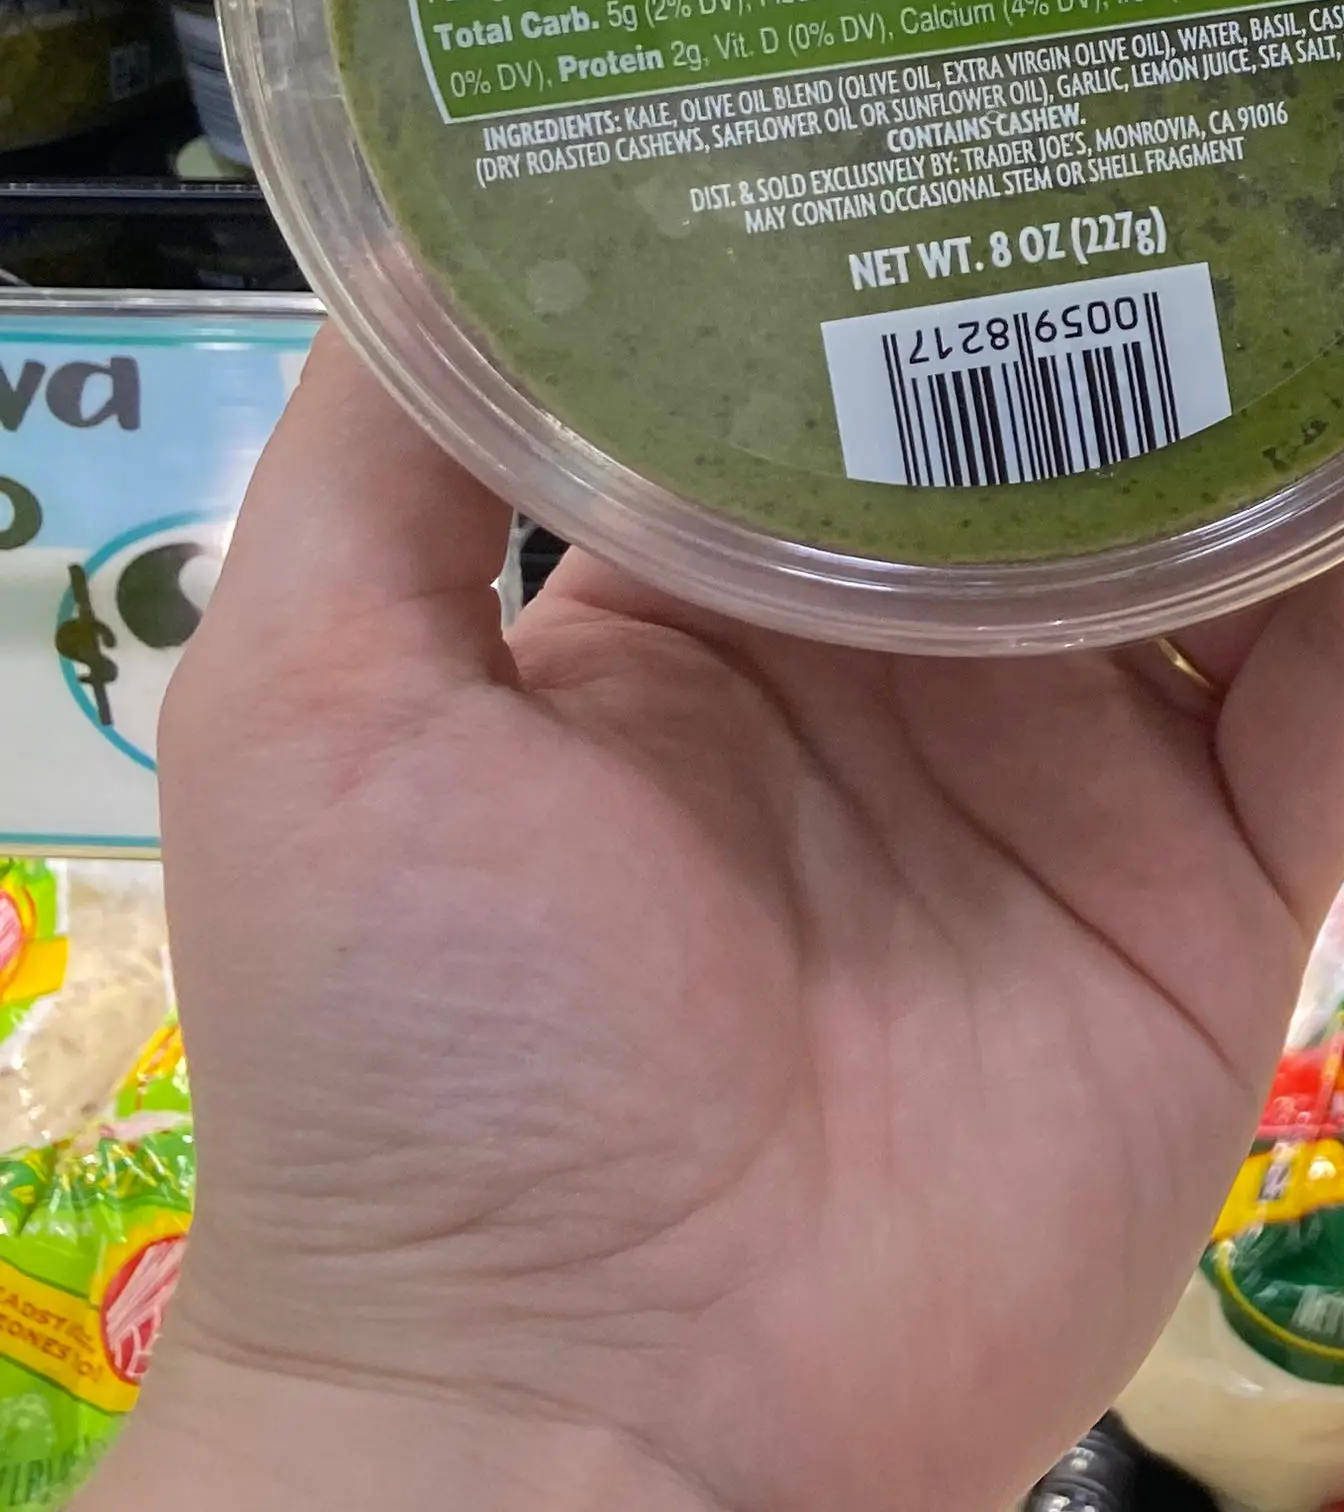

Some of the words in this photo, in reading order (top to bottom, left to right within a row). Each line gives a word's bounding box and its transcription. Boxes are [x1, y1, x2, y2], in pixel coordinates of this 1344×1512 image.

[483, 111, 622, 151] INGREDIENTS:
[625, 104, 677, 131] KALE,
[682, 94, 738, 122] OLIVE
[741, 90, 771, 115] OIL
[774, 81, 833, 112] BLEND
[839, 70, 899, 104] (OLIVE
[903, 64, 942, 92] OIL,
[943, 54, 1003, 85] EXTRA
[1006, 46, 1070, 77] VIRGIN
[1076, 38, 1128, 66] OLIVE
[1131, 30, 1176, 60] OIL),
[1178, 22, 1248, 52] WATER,
[1251, 13, 1305, 42] BASIL,
[887, 118, 990, 153] CONTAINS
[998, 103, 1086, 136] CASHEW.
[691, 186, 736, 213] DIST.
[740, 184, 754, 204] &
[757, 175, 806, 204] SOLD
[811, 159, 923, 196] EXCLUSIVELY
[930, 154, 961, 178] BY:
[965, 140, 1035, 173] TRADER
[1038, 134, 1091, 163] JOE'S,
[1096, 118, 1204, 153] MONROVIA,
[1209, 111, 1233, 134] CA
[1236, 103, 1289, 131] 91016
[848, 247, 910, 291] NET
[922, 236, 984, 280] WT.
[990, 231, 1012, 269] 8
[1020, 222, 1066, 262] OZ
[1071, 206, 1167, 266] (227g)
